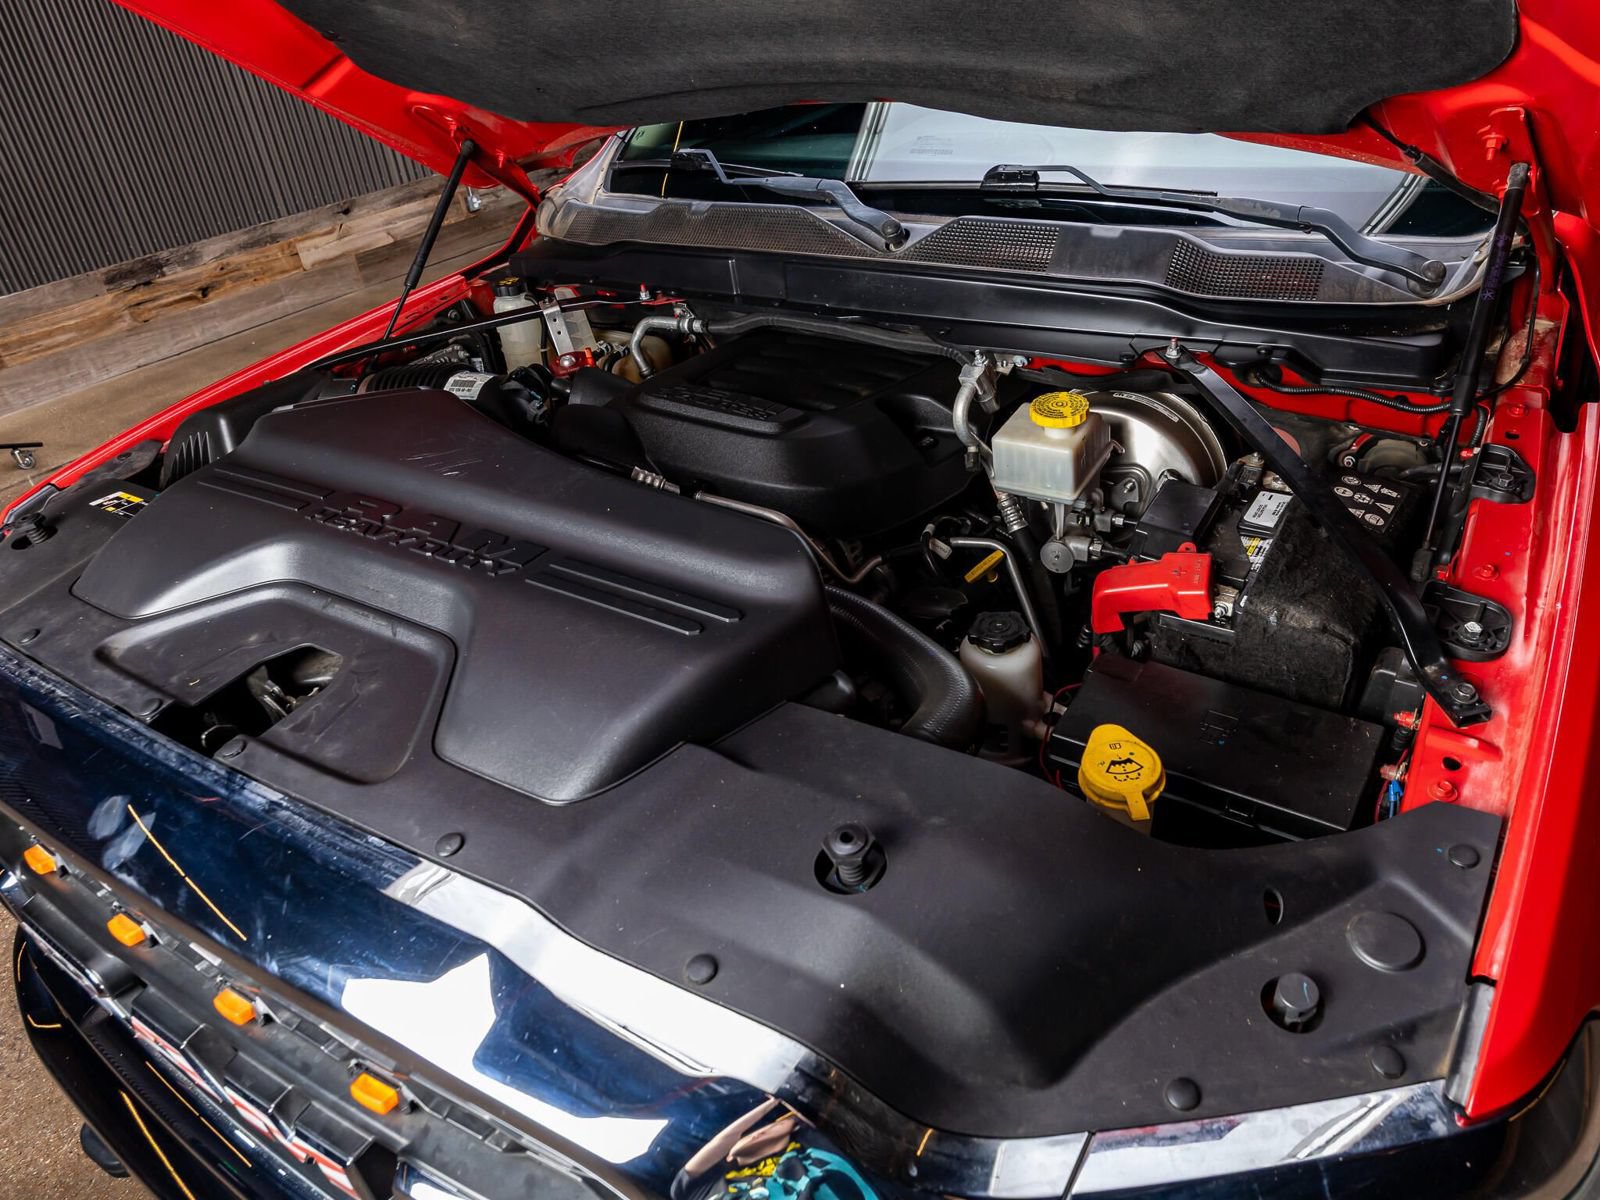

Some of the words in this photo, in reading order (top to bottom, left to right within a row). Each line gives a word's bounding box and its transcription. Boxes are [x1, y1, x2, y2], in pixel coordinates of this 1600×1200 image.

[304, 507, 417, 546] HEAVY
[409, 539, 518, 576] DUTY
[324, 492, 549, 567] RAM
